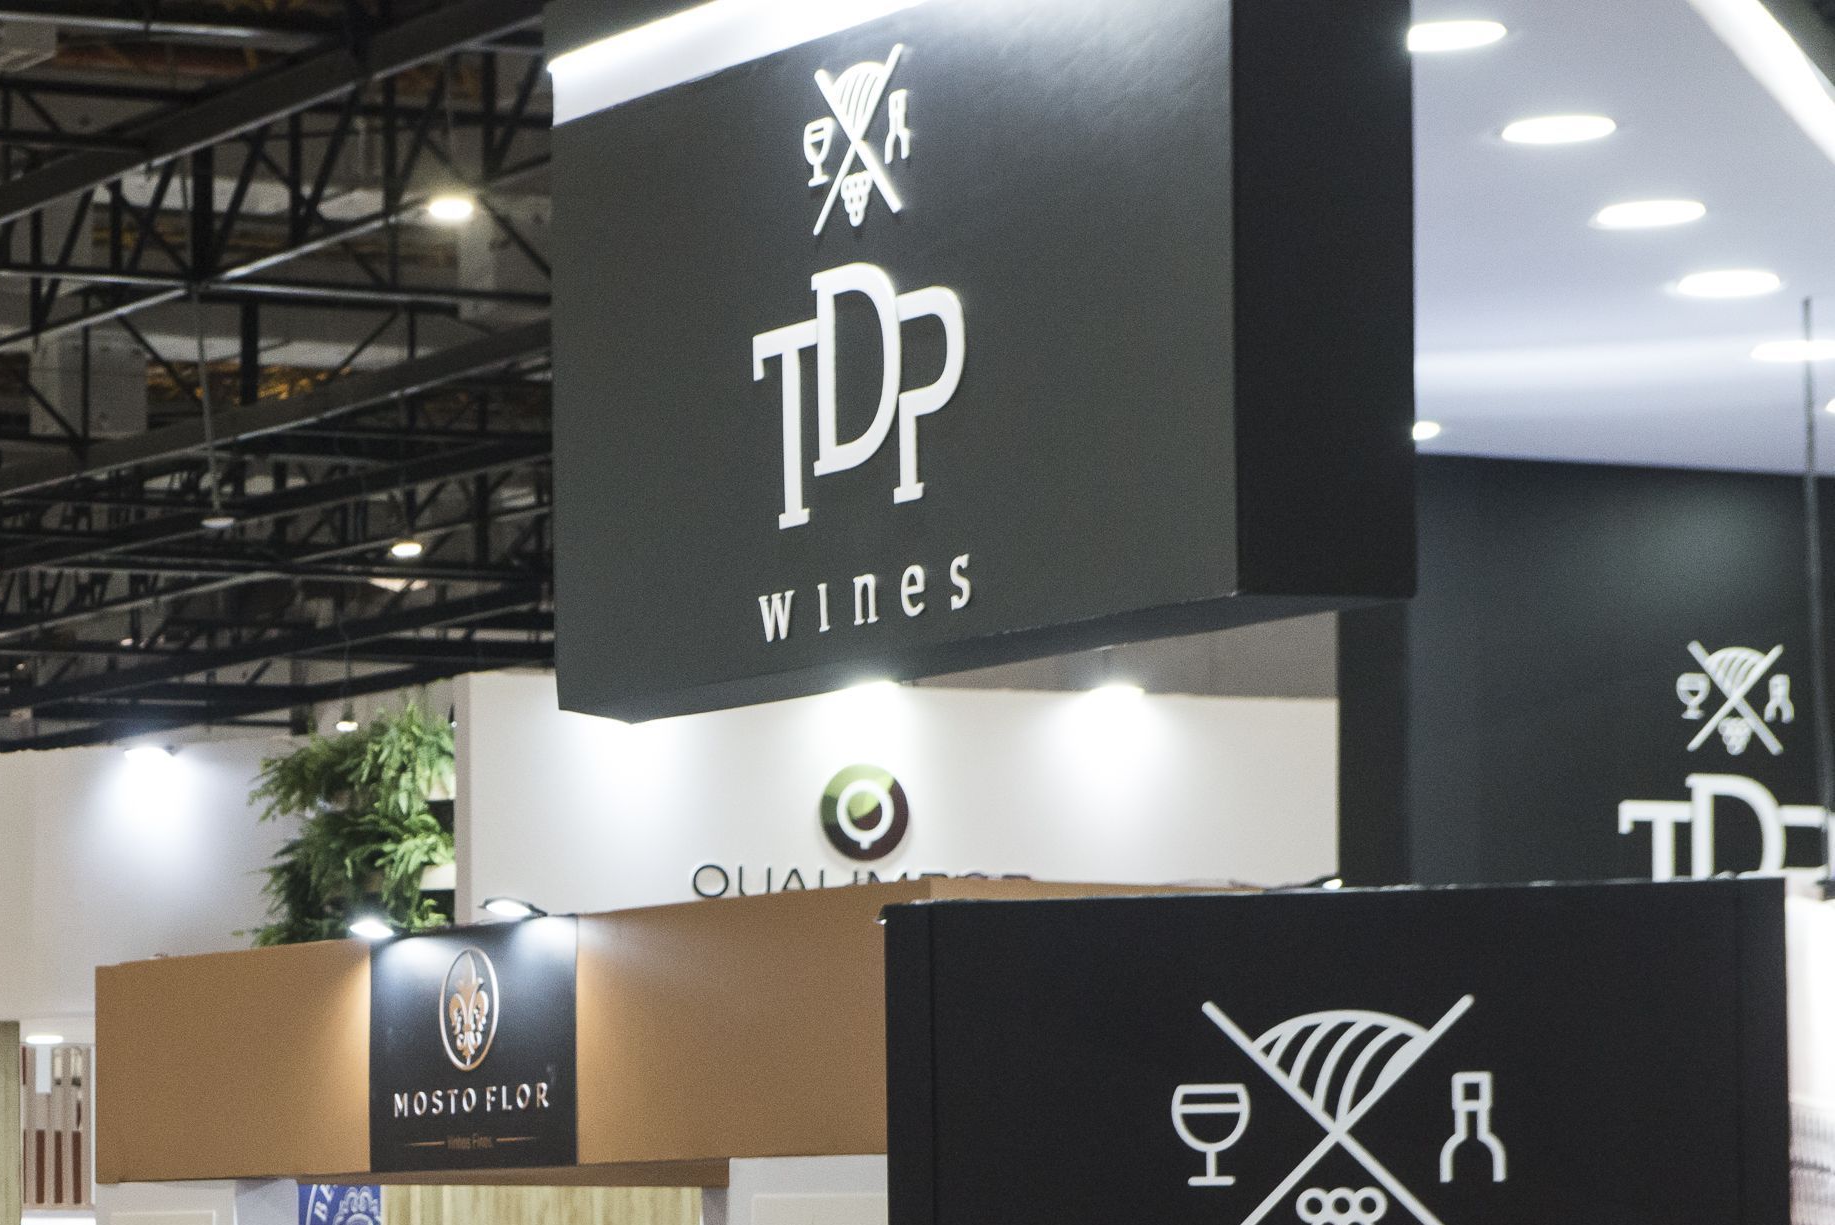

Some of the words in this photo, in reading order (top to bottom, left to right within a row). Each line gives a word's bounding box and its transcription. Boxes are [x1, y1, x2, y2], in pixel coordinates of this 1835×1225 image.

[753, 262, 965, 530] TDP
[759, 553, 972, 643] wines
[393, 1087, 477, 1118] MOSTO
[485, 1081, 550, 1112] FLOR
